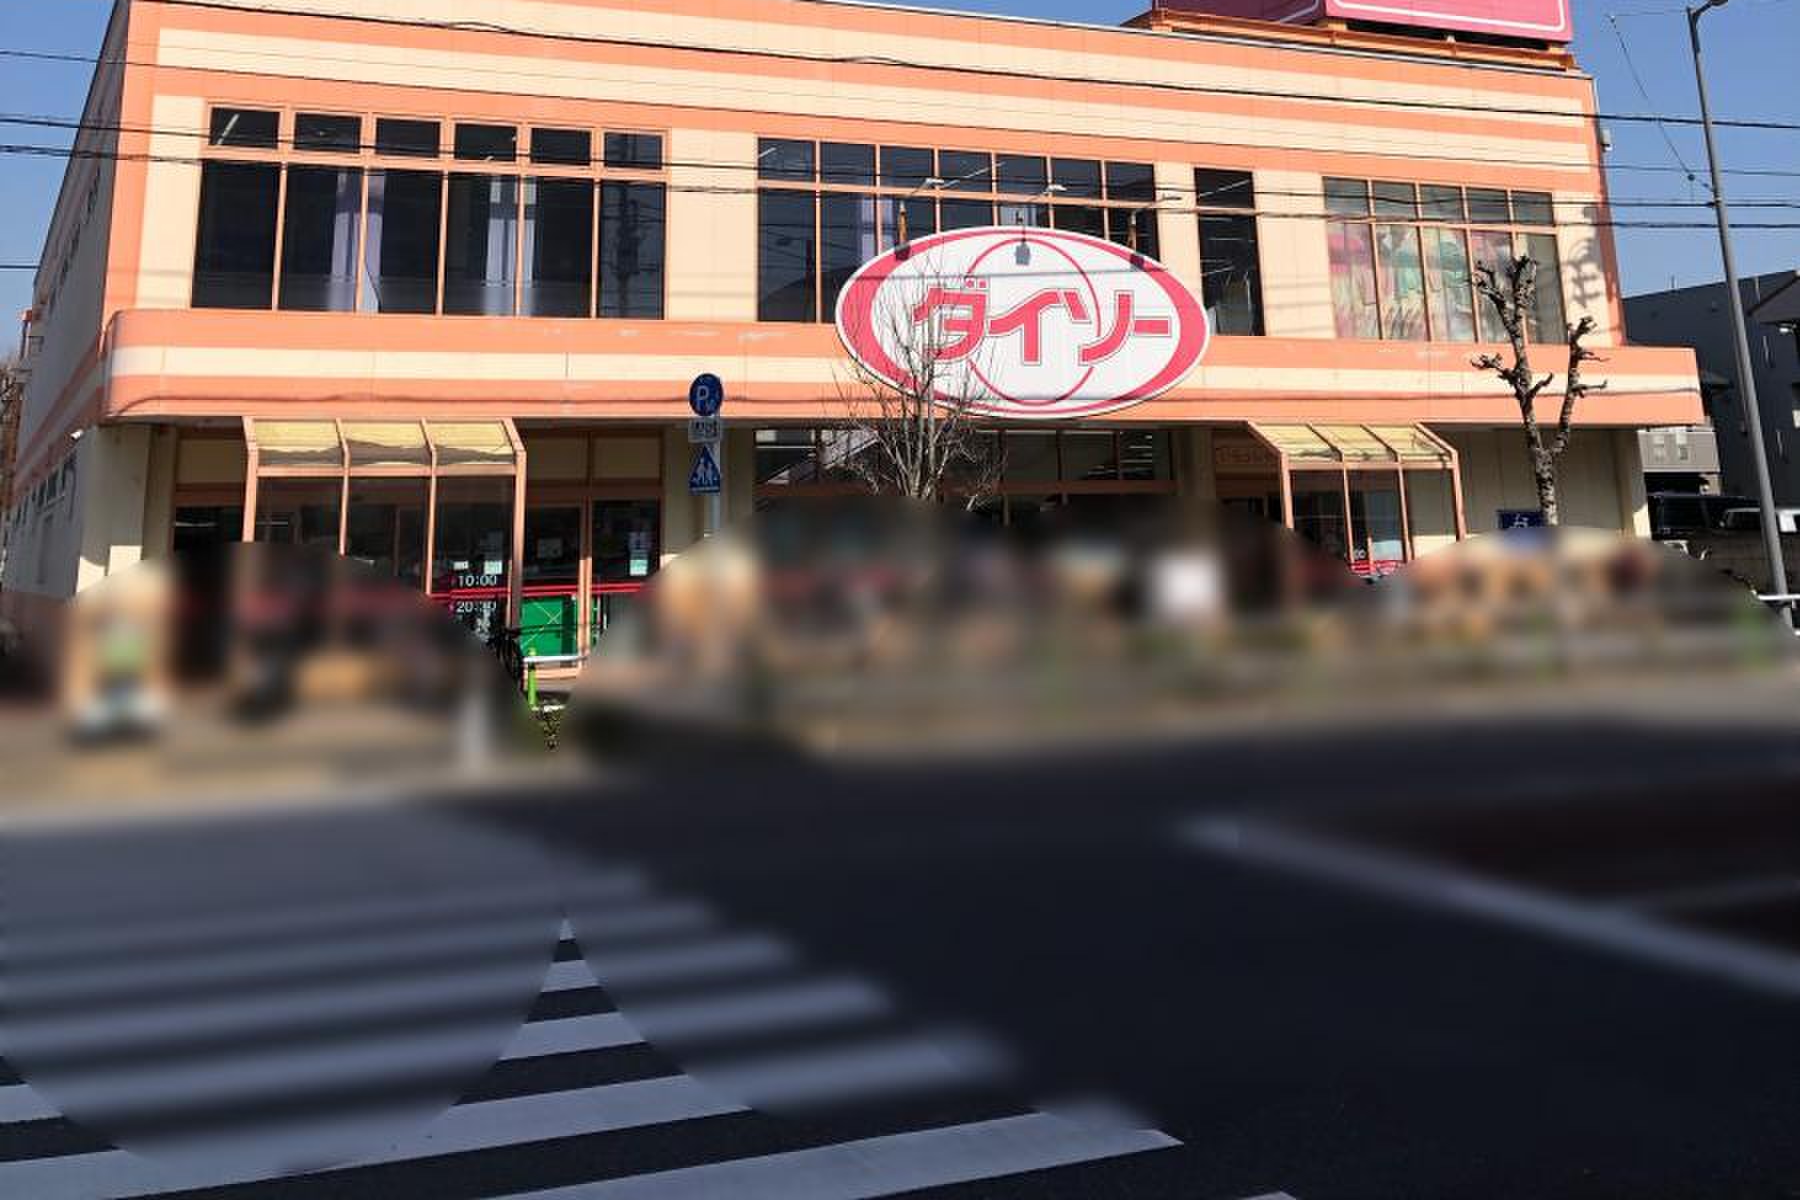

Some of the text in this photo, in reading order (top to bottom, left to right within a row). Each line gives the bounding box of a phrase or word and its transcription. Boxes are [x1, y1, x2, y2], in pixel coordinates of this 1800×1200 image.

[912, 278, 1172, 366] ダイソー
[458, 575, 497, 587] 10:00
